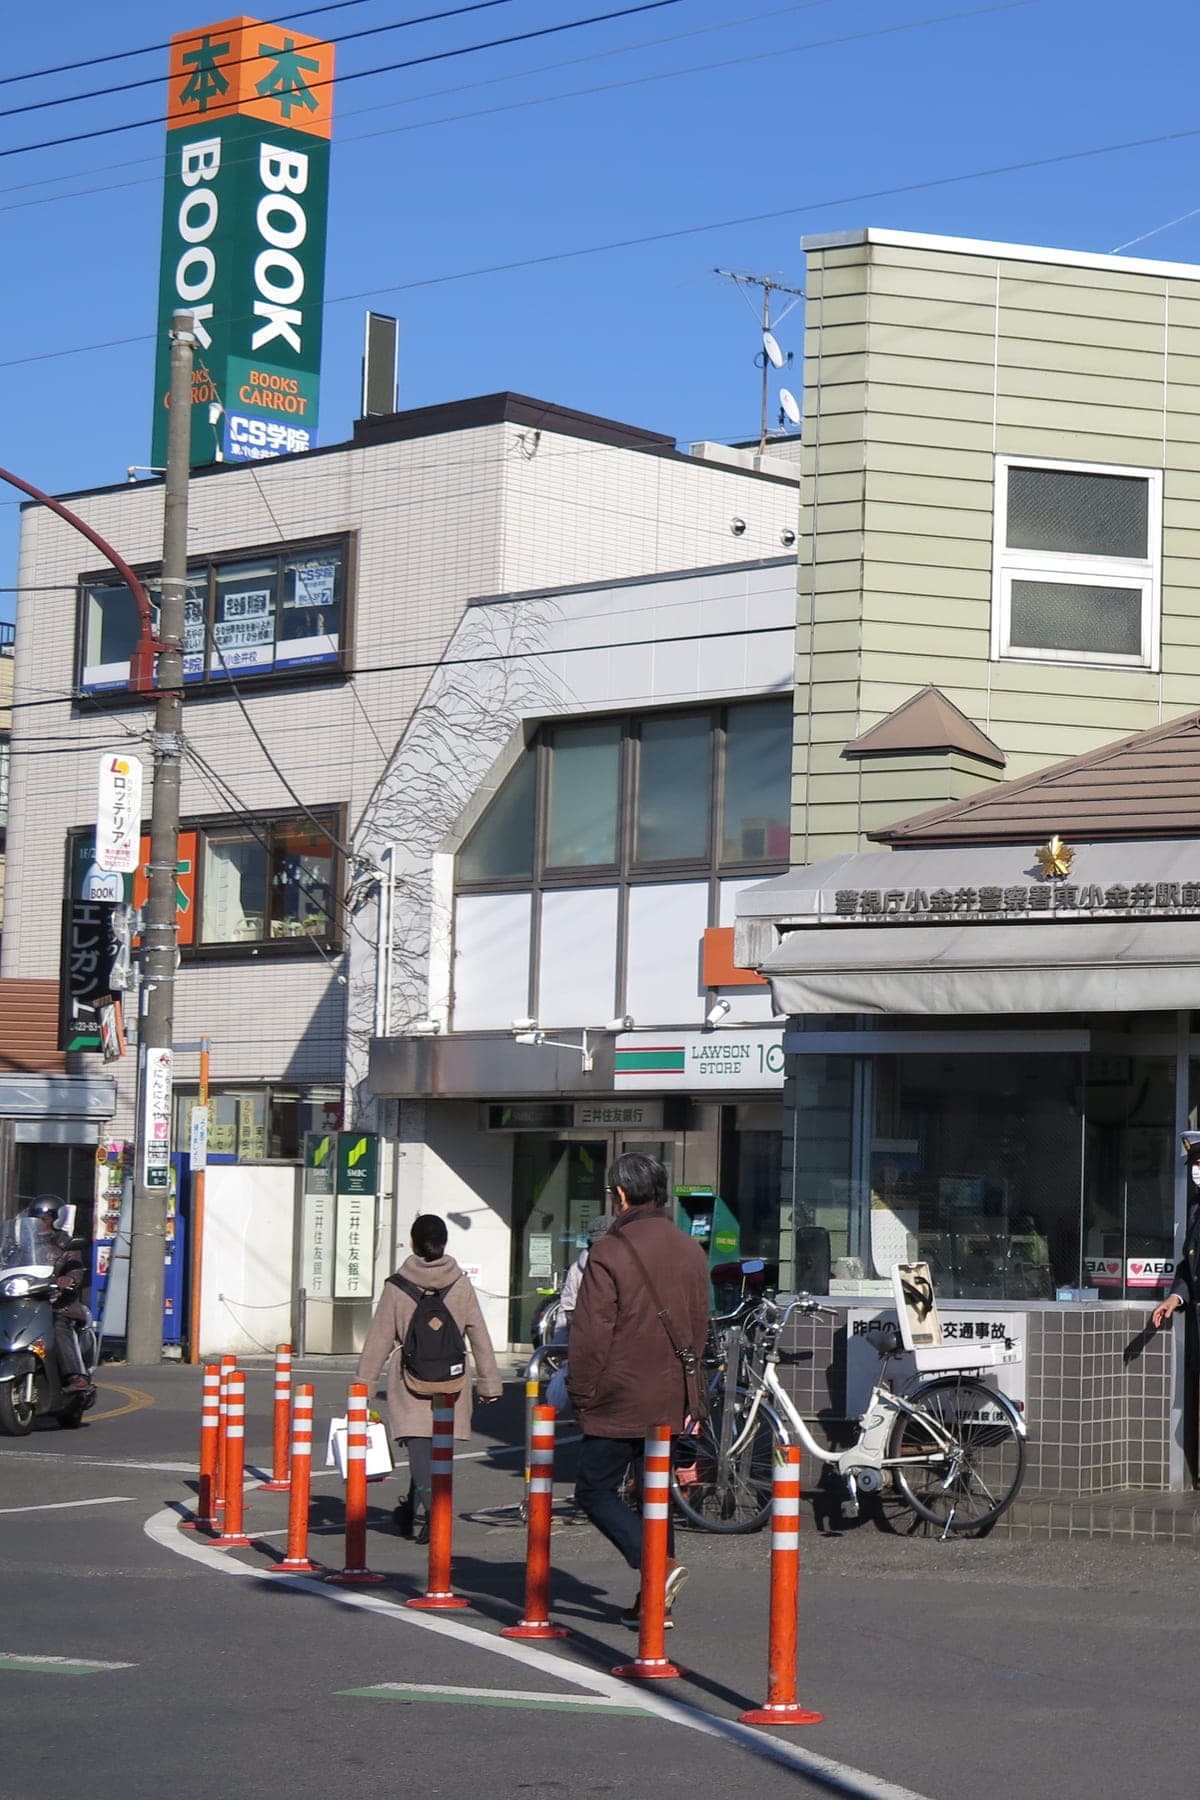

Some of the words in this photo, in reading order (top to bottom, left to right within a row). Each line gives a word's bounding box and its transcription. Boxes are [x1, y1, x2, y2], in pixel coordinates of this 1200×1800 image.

[179, 33, 231, 114] 本
[255, 37, 320, 120] 本
[175, 136, 222, 351] BOOK
[251, 142, 309, 354] BOOK
[238, 385, 307, 416] CARROT
[249, 370, 298, 394] BOOKS
[230, 416, 310, 453] CS学院
[112, 777, 126, 844] ロッテリア
[90, 887, 115, 899] BOOK
[71, 905, 101, 1018] エレガント
[692, 1044, 750, 1059] LAWSON
[699, 1062, 742, 1075] STORE
[582, 1109, 644, 1123] 三井住友銀行
[346, 1169, 367, 1177] SMBC
[313, 1200, 324, 1290] 三井住友銀行
[348, 1200, 361, 1291] 三井住友銀行
[1143, 1263, 1174, 1274] AED
